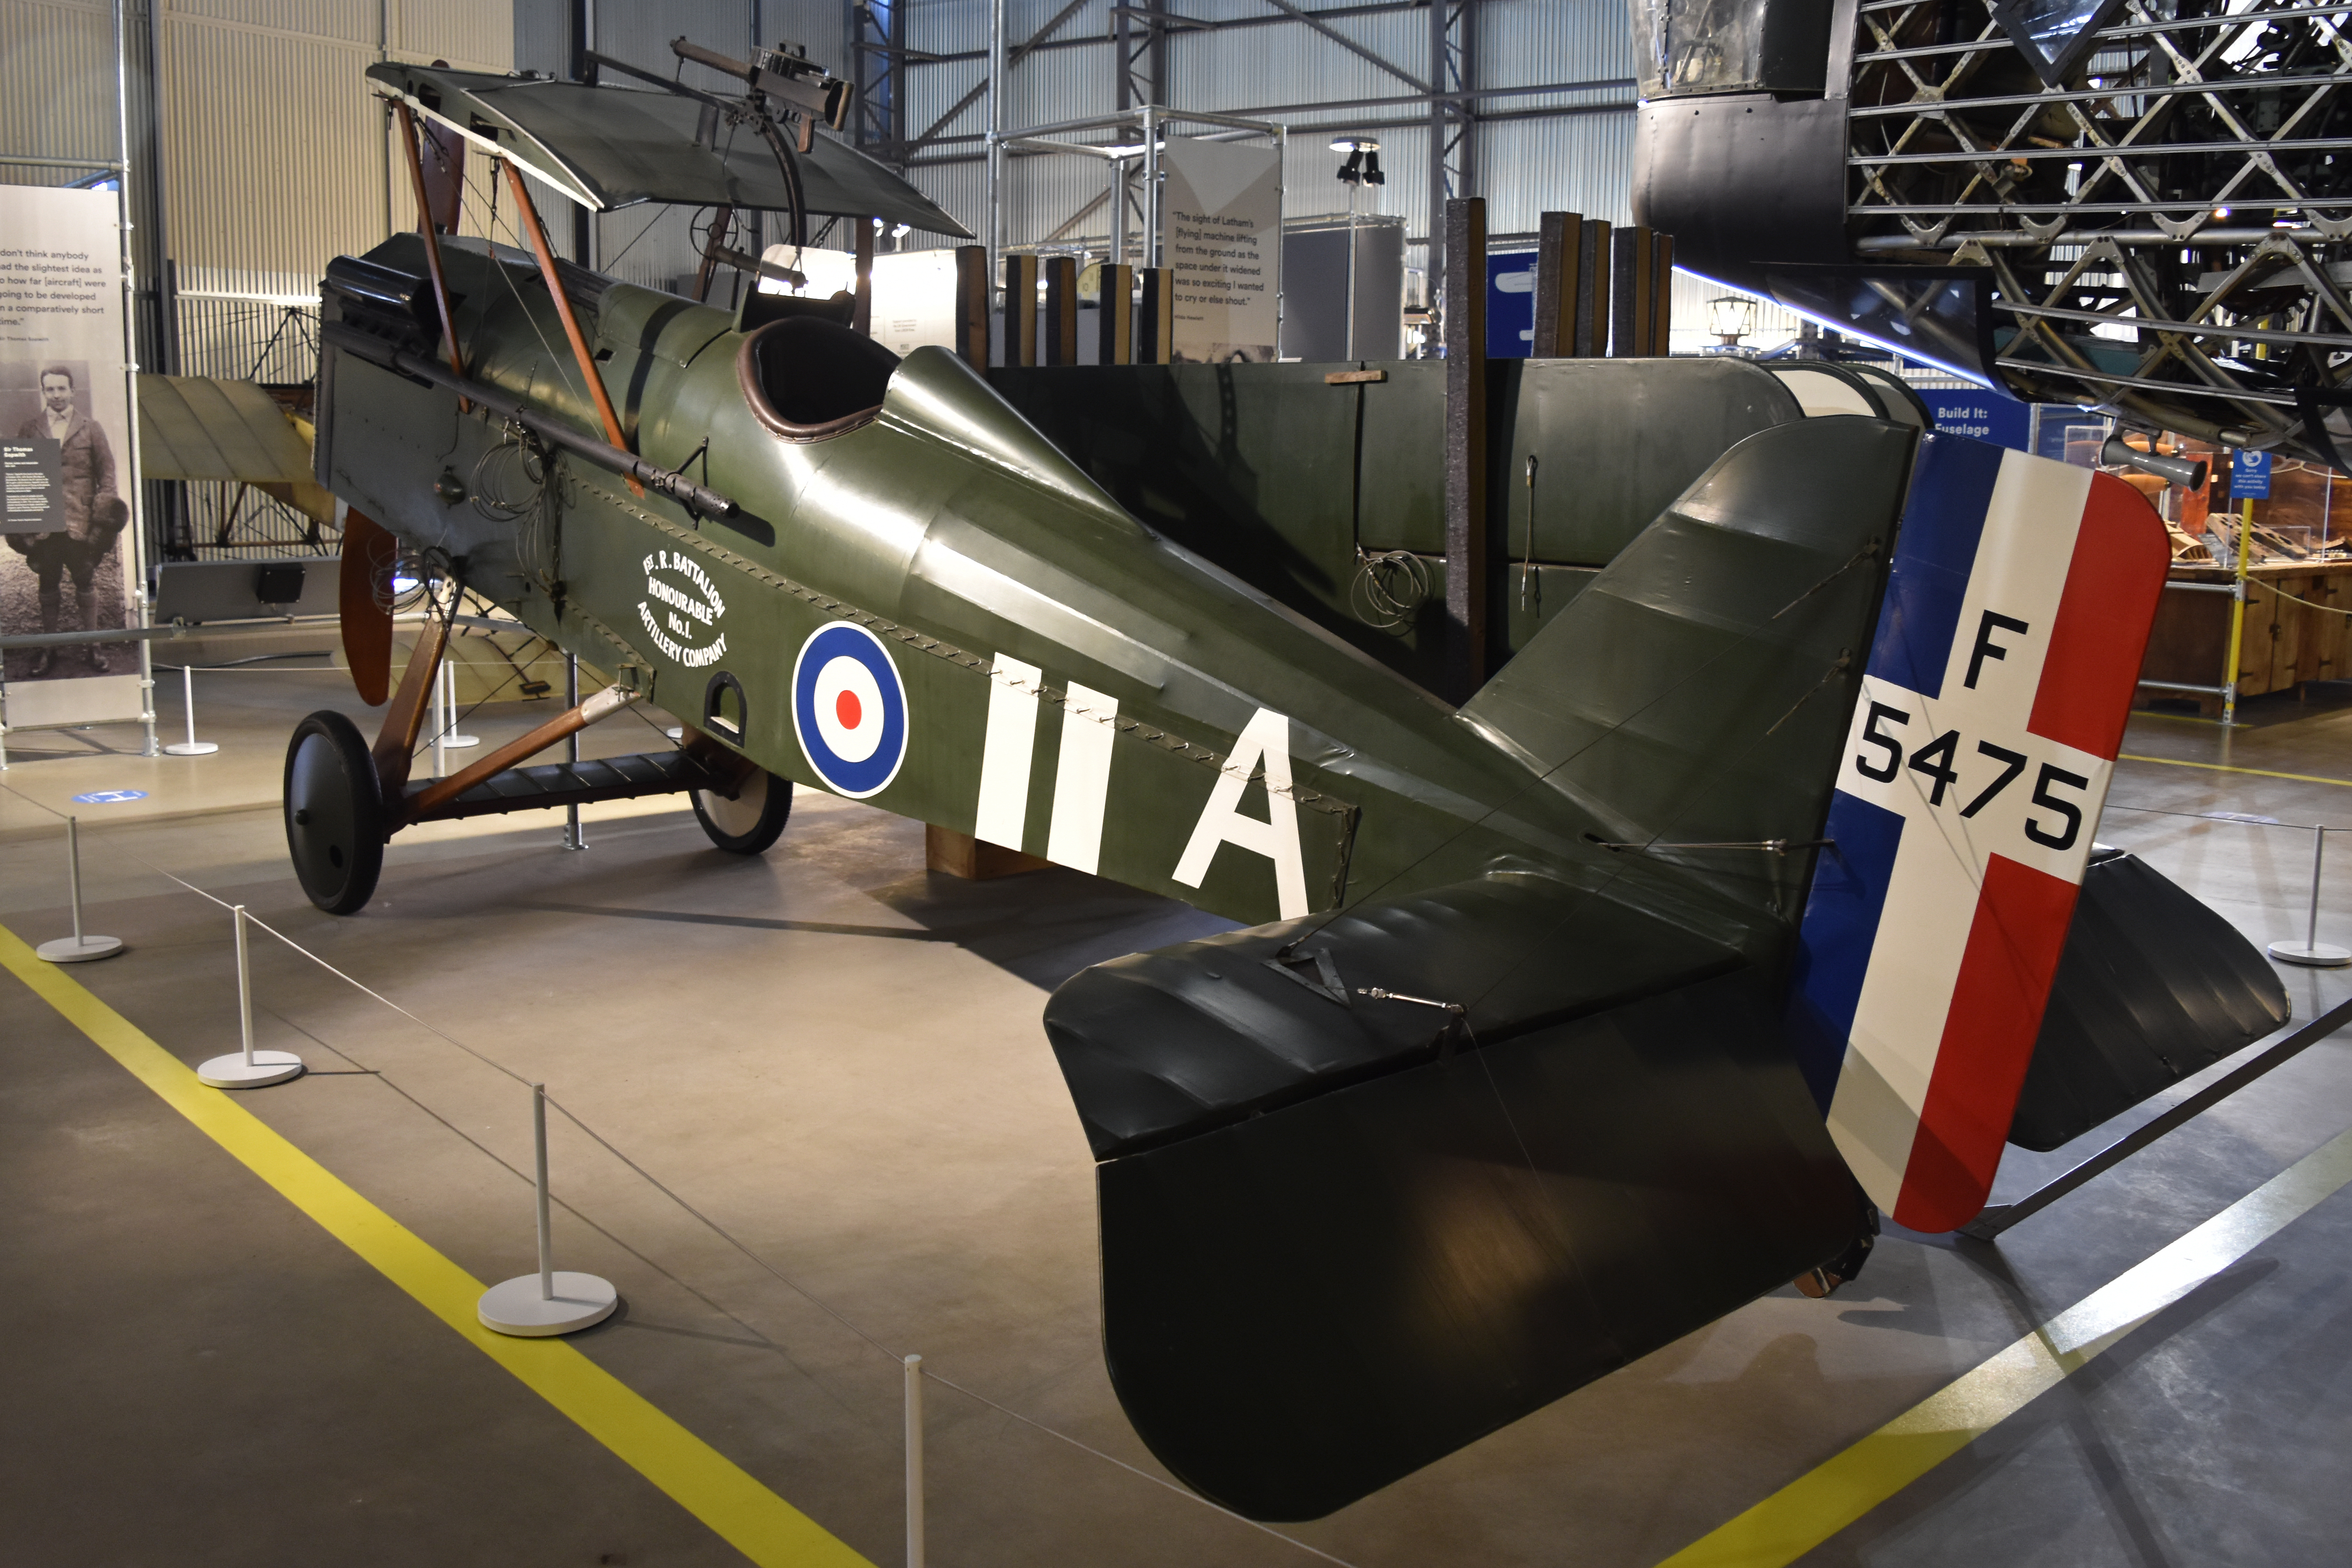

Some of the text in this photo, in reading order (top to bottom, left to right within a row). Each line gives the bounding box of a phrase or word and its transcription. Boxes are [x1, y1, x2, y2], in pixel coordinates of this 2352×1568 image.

[1192, 214, 1210, 225] sight
[1212, 216, 1220, 224] of
[1221, 217, 1253, 228] Latham's
[1176, 227, 1257, 246] [flying] machine lifting
[51, 251, 89, 261] anybody
[1176, 244, 1194, 253] from
[1195, 246, 1207, 255] the
[1209, 249, 1236, 258] ground
[1247, 250, 1259, 260] the
[32, 264, 69, 273] slightest
[71, 265, 90, 273] idea
[1175, 262, 1261, 276] space under it widened
[45, 277, 82, 288] [aircraft]
[1202, 279, 1231, 291] exciting
[50, 292, 96, 301] developed
[1185, 295, 1197, 304] cry
[1209, 295, 1223, 304] else
[16, 305, 79, 315] comparatively
[1938, 407, 1988, 418] Build It:
[1934, 423, 1990, 437] Fuselage
[673, 552, 725, 619] BATTALION
[648, 576, 713, 626] HONOURABLE
[637, 601, 727, 667] ARTILLERY COMPANY
[1963, 609, 2029, 690] F
[1856, 700, 2089, 851] 5475
[1171, 707, 1309, 921] A
